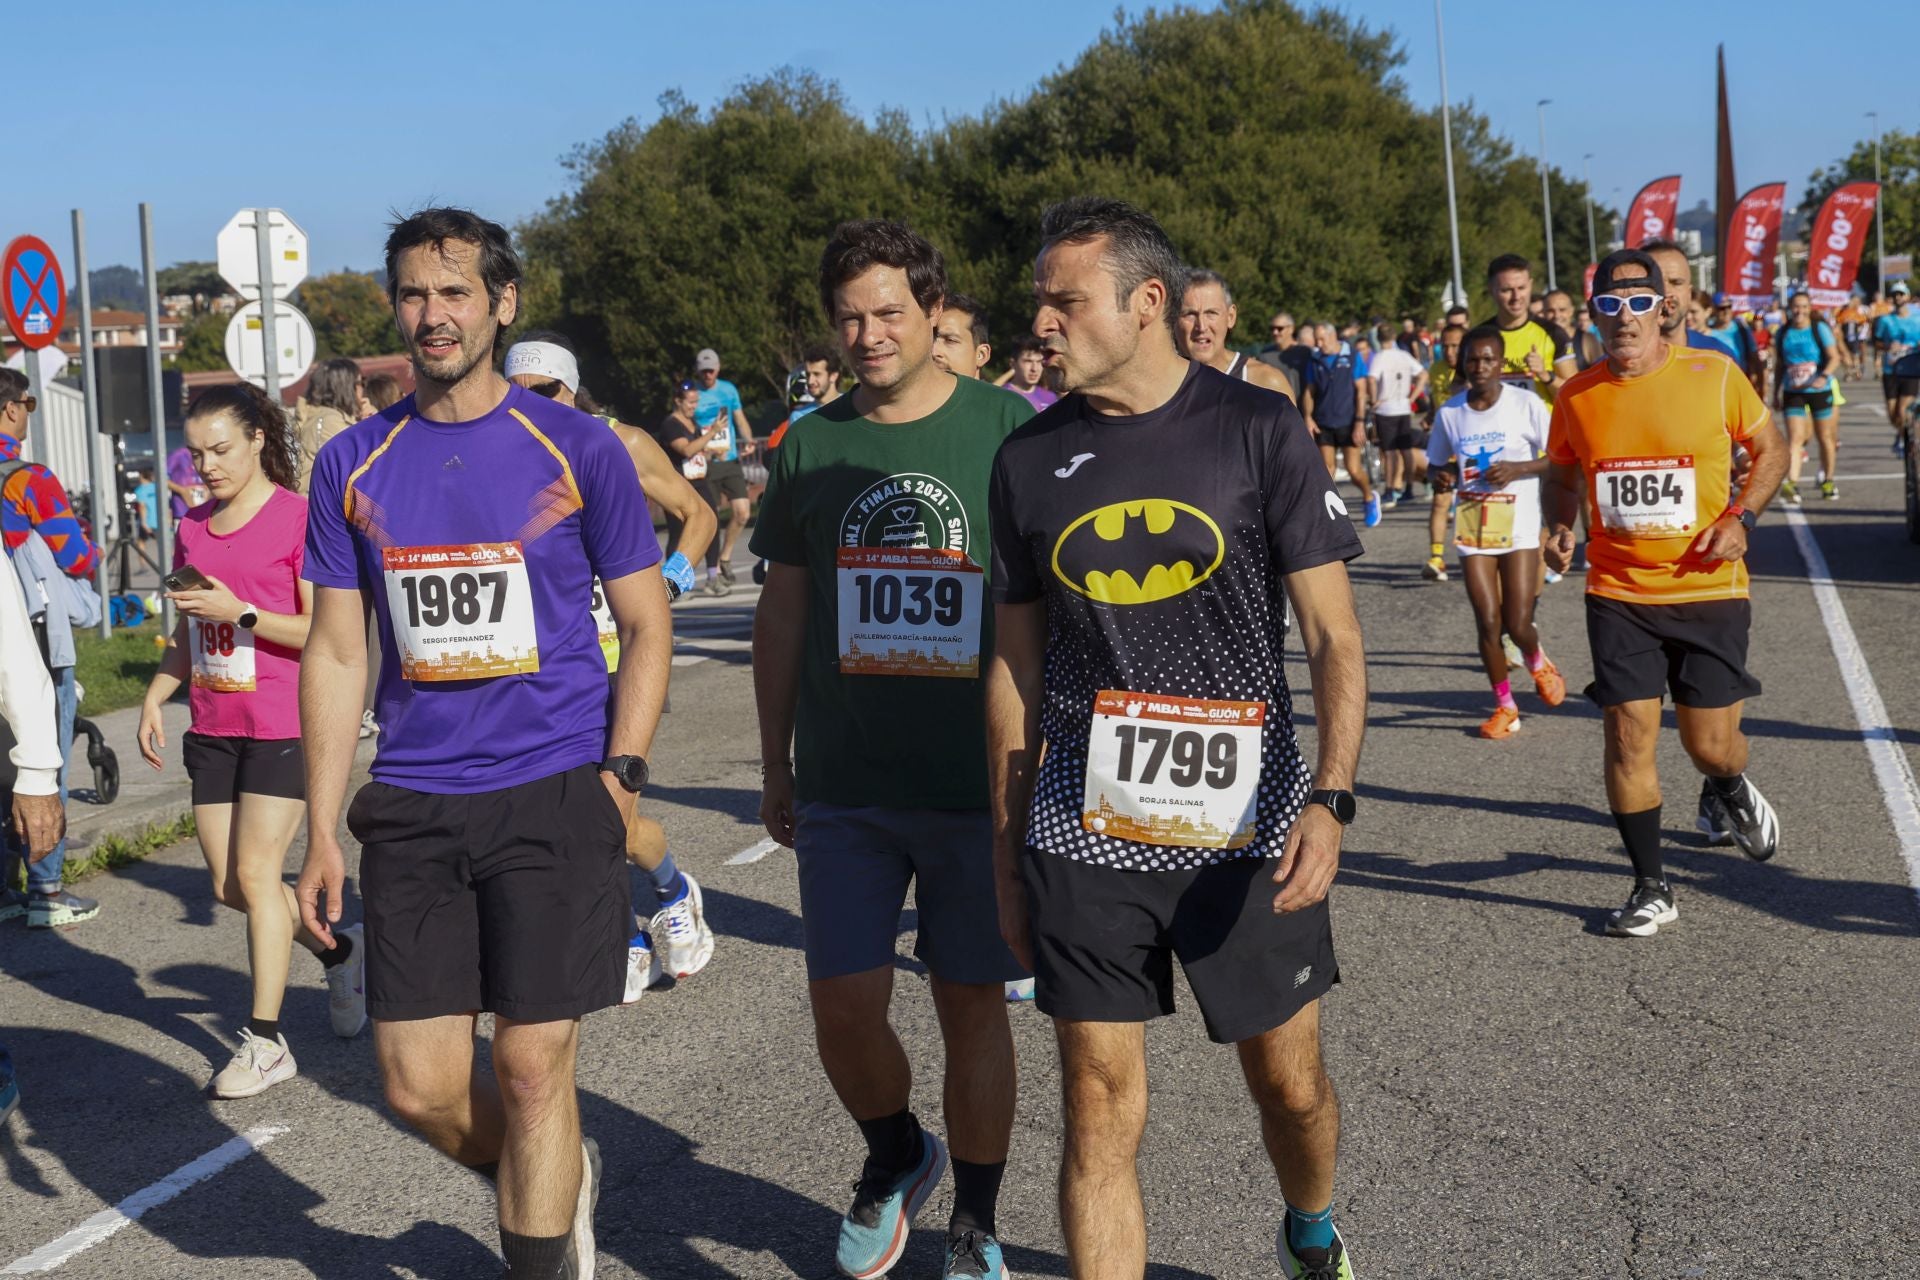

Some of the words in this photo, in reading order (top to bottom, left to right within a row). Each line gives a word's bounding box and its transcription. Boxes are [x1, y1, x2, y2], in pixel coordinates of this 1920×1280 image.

[1818, 253, 1844, 288] 2h
[859, 479, 912, 514] FINALS
[914, 480, 949, 506] 2021
[1607, 473, 1684, 507] 1864
[421, 552, 449, 563] MBA
[471, 548, 501, 561] GIJÓN
[880, 554, 909, 564] MBA
[931, 555, 961, 566] GIJÓN
[401, 570, 509, 627] 1987
[855, 574, 963, 627] 1039
[422, 637, 448, 645] SERGIO
[449, 634, 495, 643] FERNANDEZ
[853, 633, 892, 641] GUILLERMO
[892, 633, 963, 644] GARCÍA-BARAGAÑO
[1146, 702, 1181, 716] MBA
[1208, 707, 1241, 720] GIJÓN
[1115, 724, 1238, 790] 1799
[1139, 796, 1167, 805] BORJA
[1169, 798, 1205, 807] SALINAS
